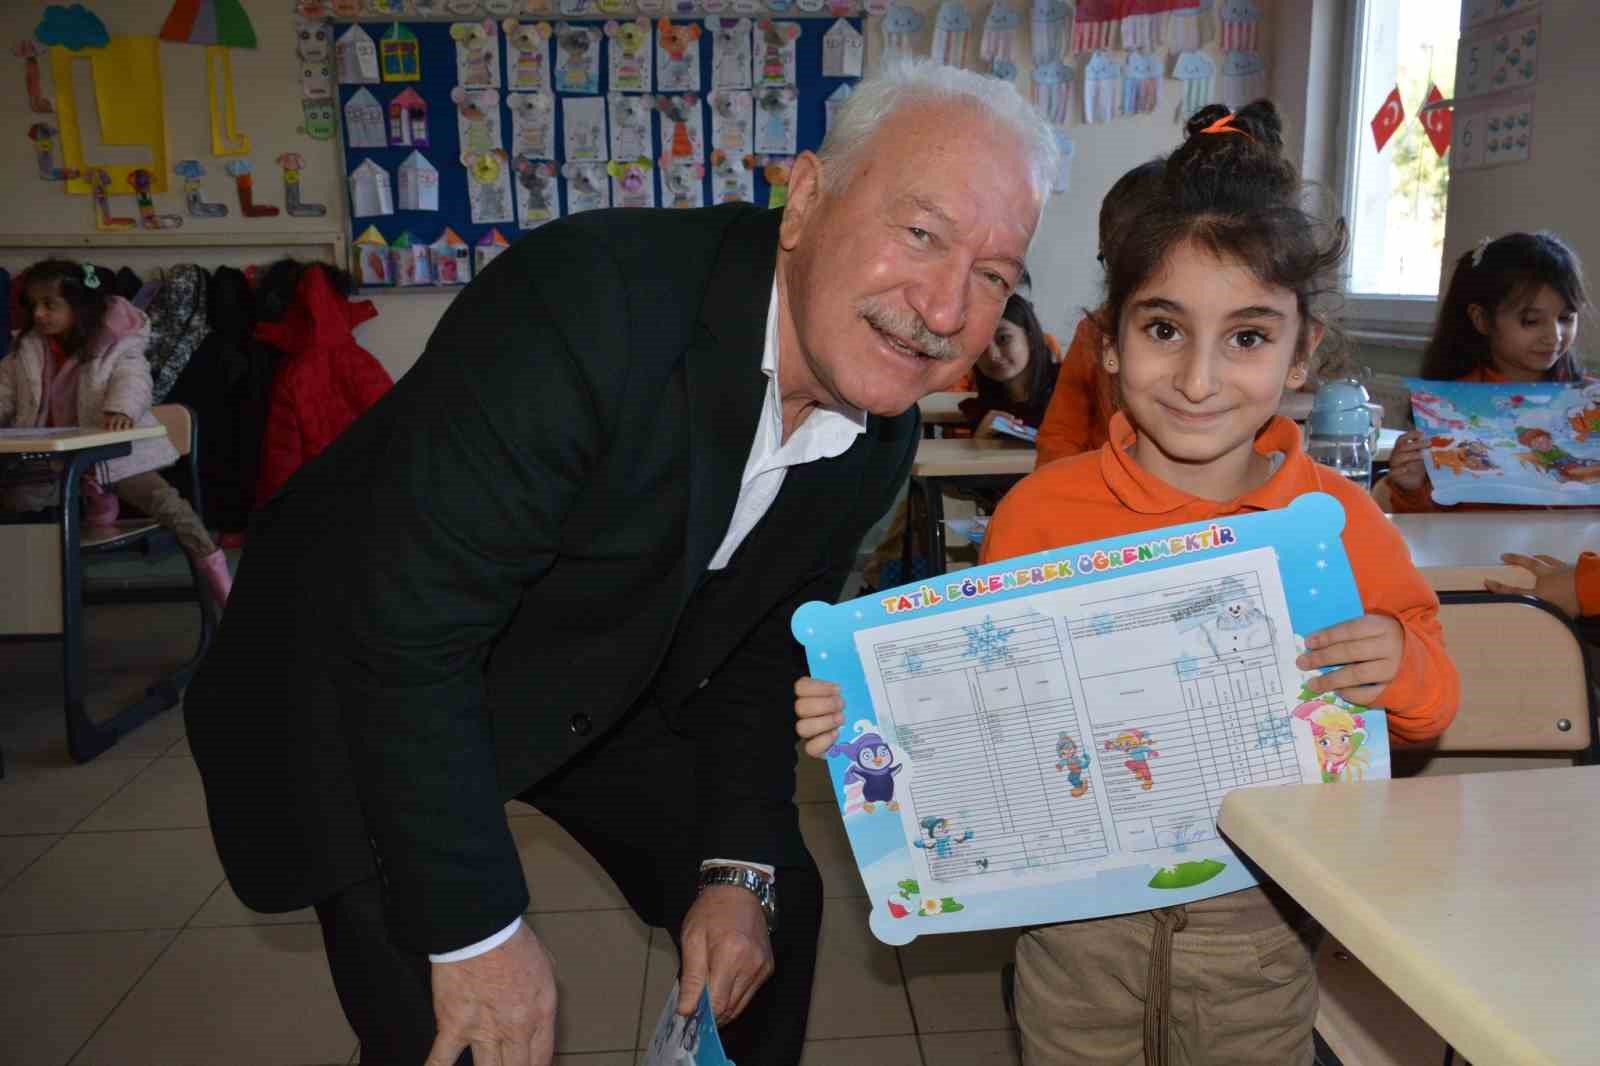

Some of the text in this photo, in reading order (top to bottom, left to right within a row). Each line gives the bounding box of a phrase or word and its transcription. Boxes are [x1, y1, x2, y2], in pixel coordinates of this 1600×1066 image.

[882, 525, 1235, 613] TATİL EĞLENEREK ÖĞRENMEKTİR
